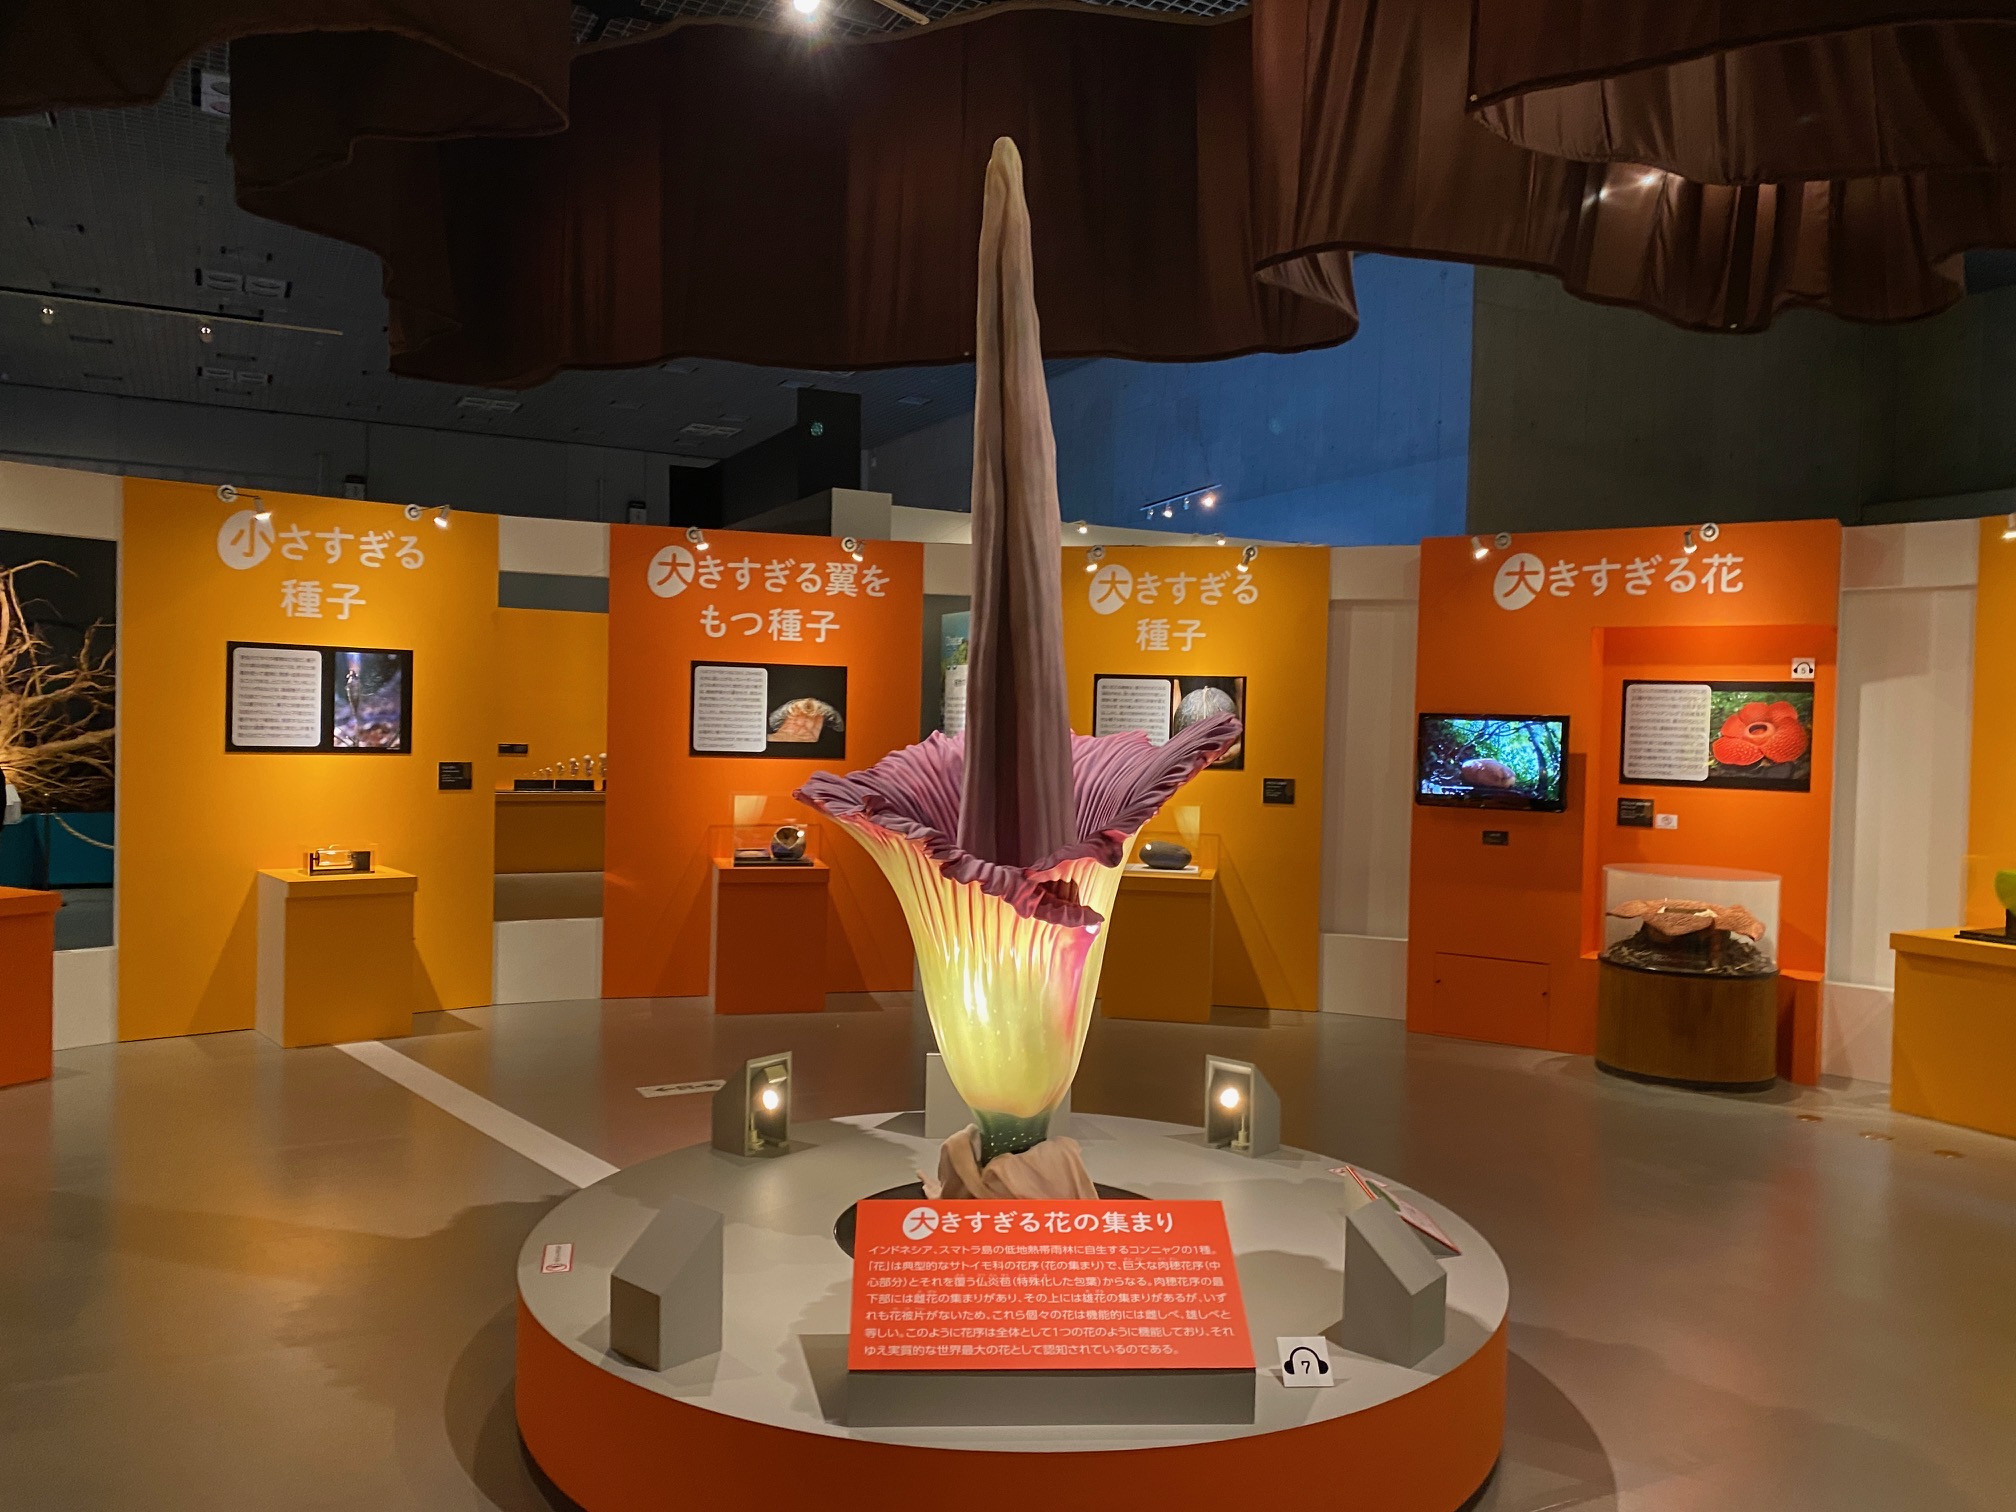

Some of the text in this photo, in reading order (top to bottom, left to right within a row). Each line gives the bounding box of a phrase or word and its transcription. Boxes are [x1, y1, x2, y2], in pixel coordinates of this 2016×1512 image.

[217, 511, 425, 570] 小さすぎる
[647, 546, 890, 598] 大きすぎる翼を
[1089, 564, 1259, 615] 大きすぎる
[1493, 553, 1745, 611] 大きすぎる花
[280, 579, 366, 620] 種子
[699, 604, 841, 643] もつ種子
[1136, 618, 1207, 652] 種子
[903, 1207, 1174, 1240] 大きすぎる花の集まり
[1301, 1360, 1311, 1375] 7
